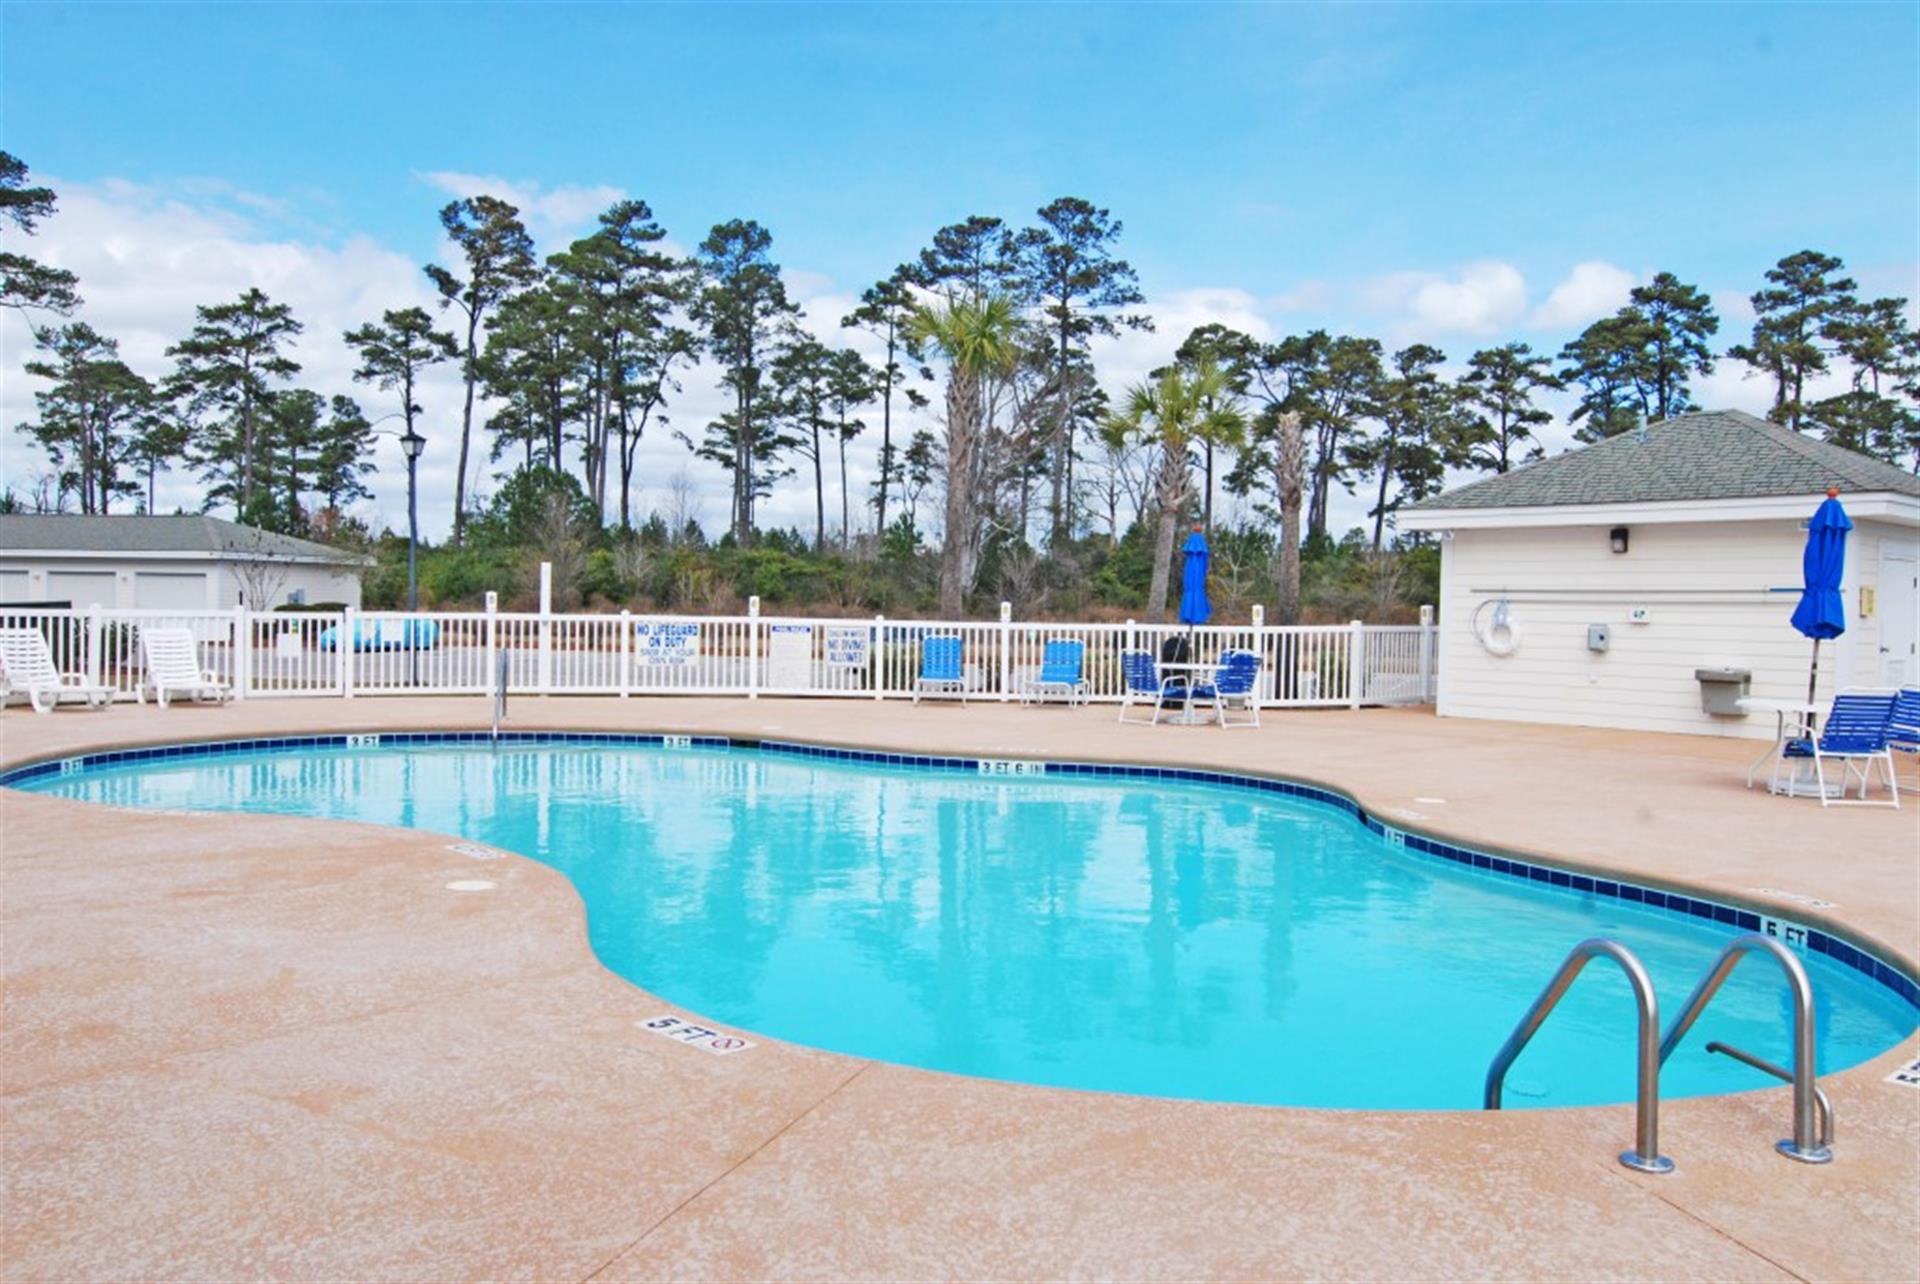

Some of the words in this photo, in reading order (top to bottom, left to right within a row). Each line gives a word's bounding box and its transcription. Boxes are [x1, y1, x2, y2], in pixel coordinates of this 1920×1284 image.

[637, 623, 649, 636] NO
[653, 624, 698, 636] LIFEGUARD
[648, 636, 660, 647] ON
[665, 636, 687, 647] DUTY
[841, 640, 865, 650] DIVING
[830, 652, 863, 662] ALLOWED
[983, 762, 991, 774] 3
[996, 762, 1009, 775] FT
[1785, 927, 1805, 945] FT
[647, 1018, 681, 1029] 5
[669, 1026, 717, 1041] FT
